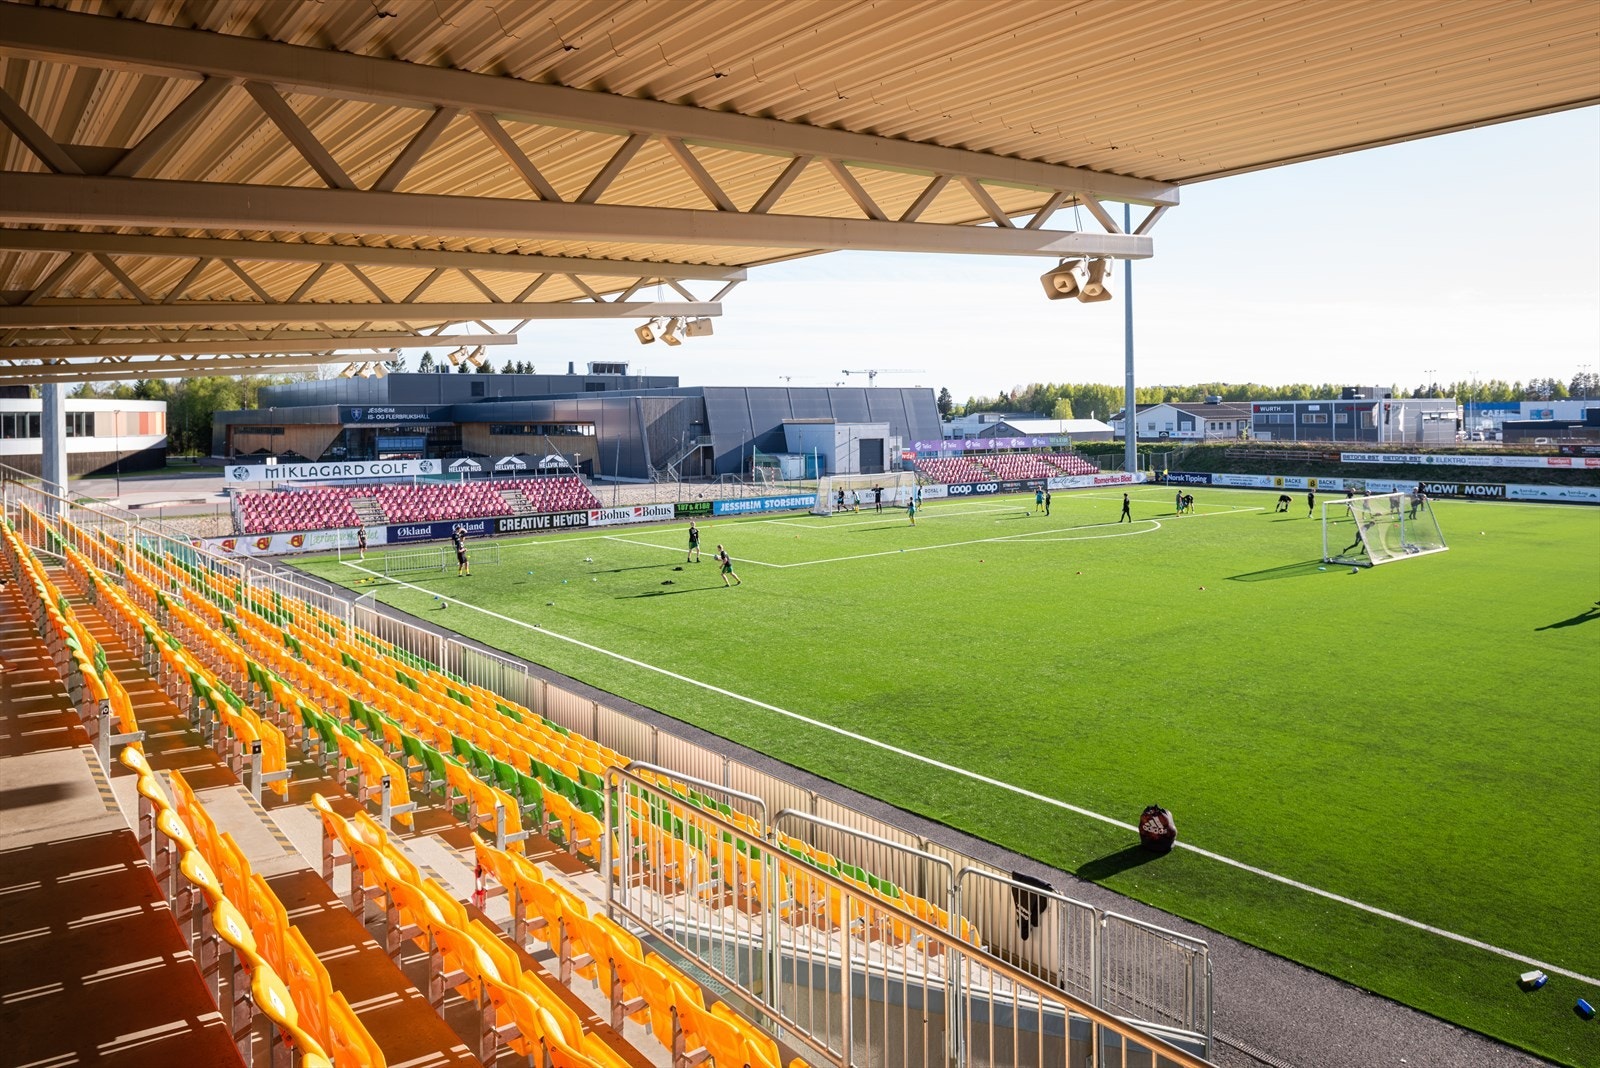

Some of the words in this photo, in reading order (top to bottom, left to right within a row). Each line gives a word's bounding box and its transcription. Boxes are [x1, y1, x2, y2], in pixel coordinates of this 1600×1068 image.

[265, 464, 365, 479] MIKLAGARD
[365, 463, 408, 475] GOLF
[448, 465, 470, 473] HELLVIK
[1094, 476, 1120, 484] Romerikes
[1121, 475, 1132, 483] Blad
[1167, 474, 1185, 482] Norsk
[1185, 474, 1208, 484] Tipping
[949, 485, 972, 494] coop
[976, 483, 998, 492] coop
[720, 501, 761, 512] JESSHEIM
[764, 497, 815, 508] STORSENTER
[600, 509, 630, 520] Bohus
[642, 506, 672, 516] Bohus
[500, 516, 550, 532] CREATIVE
[397, 525, 432, 537] Økland
